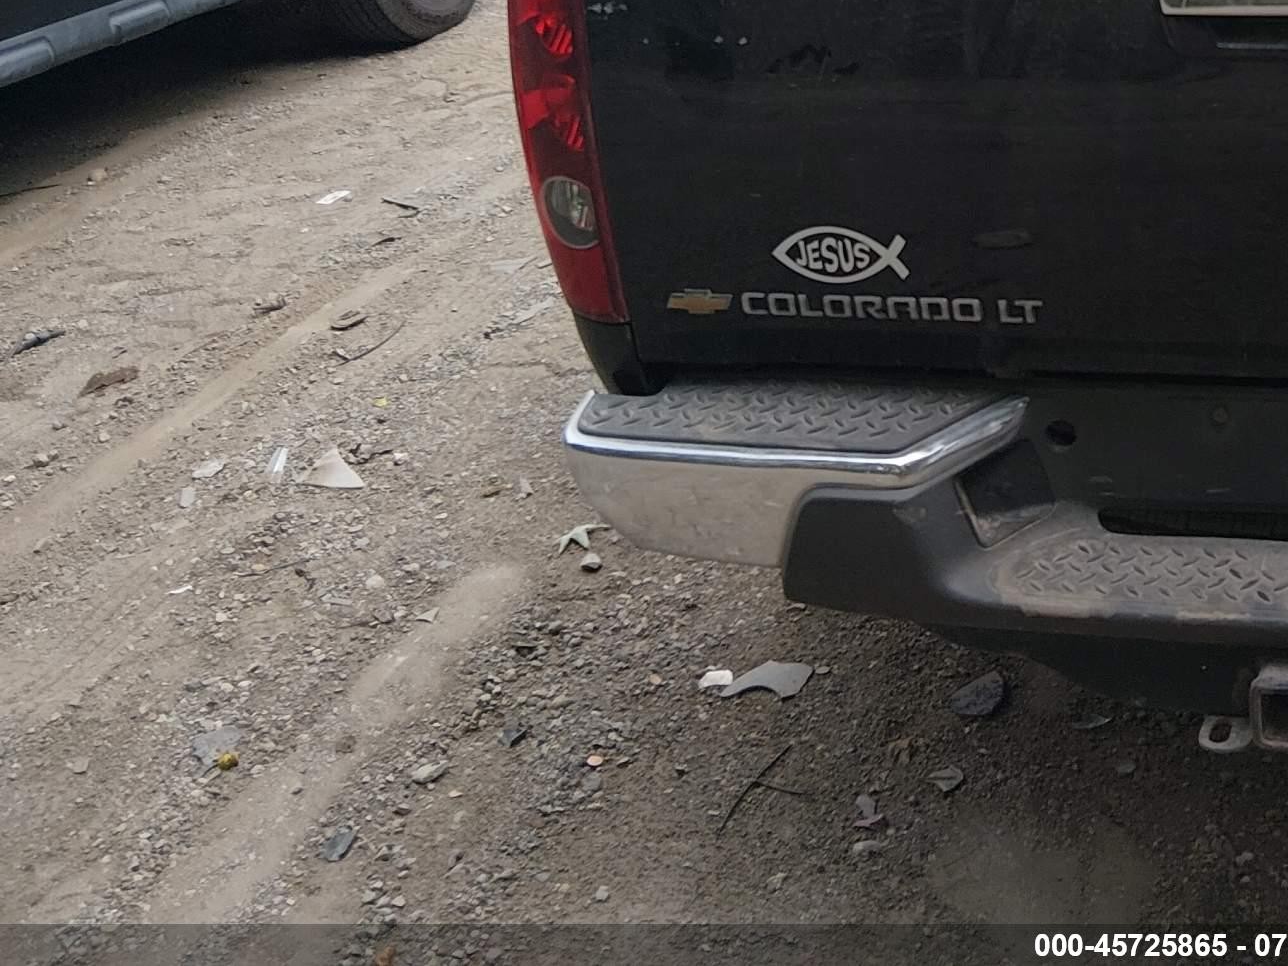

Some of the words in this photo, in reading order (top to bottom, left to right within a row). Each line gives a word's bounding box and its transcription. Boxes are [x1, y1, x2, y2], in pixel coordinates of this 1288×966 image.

[796, 236, 871, 274] JESUS
[740, 291, 983, 323] COLORADO
[996, 298, 1044, 325] LT
